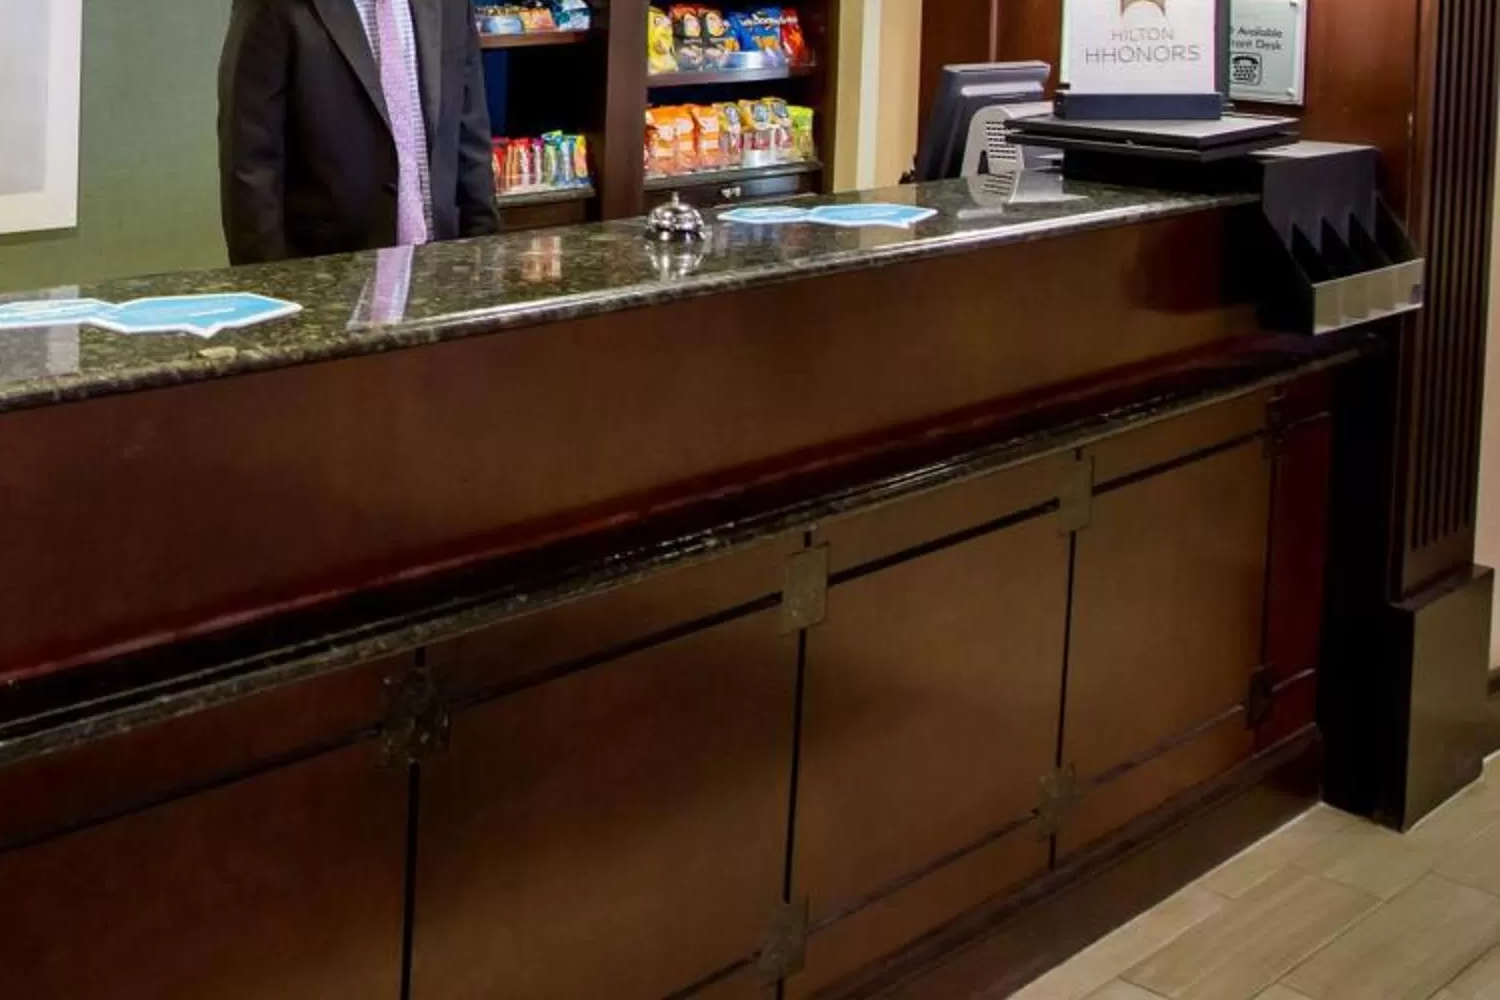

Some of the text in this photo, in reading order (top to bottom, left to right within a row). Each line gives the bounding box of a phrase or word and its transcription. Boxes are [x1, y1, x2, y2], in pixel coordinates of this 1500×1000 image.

[1111, 26, 1175, 42] HILTON
[1230, 39, 1282, 51] ront Desk
[1084, 44, 1202, 65] HHONORS
